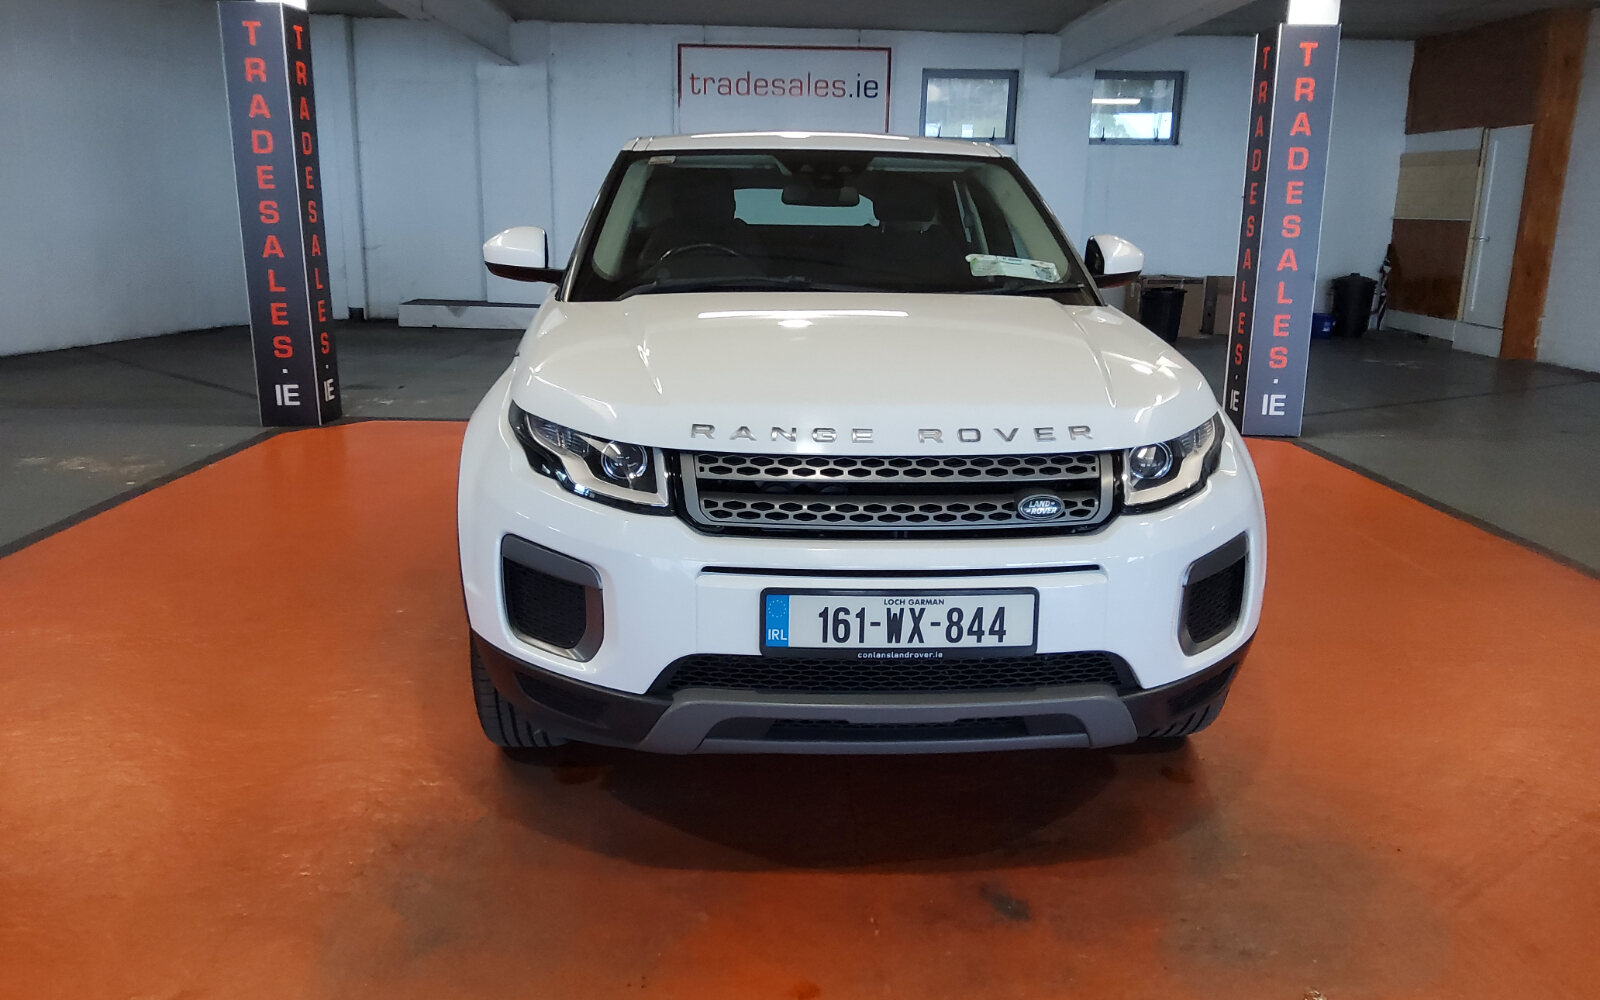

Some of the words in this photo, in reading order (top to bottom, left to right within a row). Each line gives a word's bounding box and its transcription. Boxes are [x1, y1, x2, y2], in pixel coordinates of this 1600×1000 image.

[689, 71, 879, 99] tradesales.ie
[690, 423, 875, 443] RANGE
[918, 425, 1093, 443] ROVER
[1029, 500, 1051, 508] LAND
[1030, 507, 1058, 515] ROVER
[883, 598, 906, 606] LOCH
[908, 598, 945, 606] GARMAN
[818, 606, 1007, 644] 161-WX-844
[767, 629, 788, 641] IRL
[857, 650, 944, 659] conlanslandrover.ie
